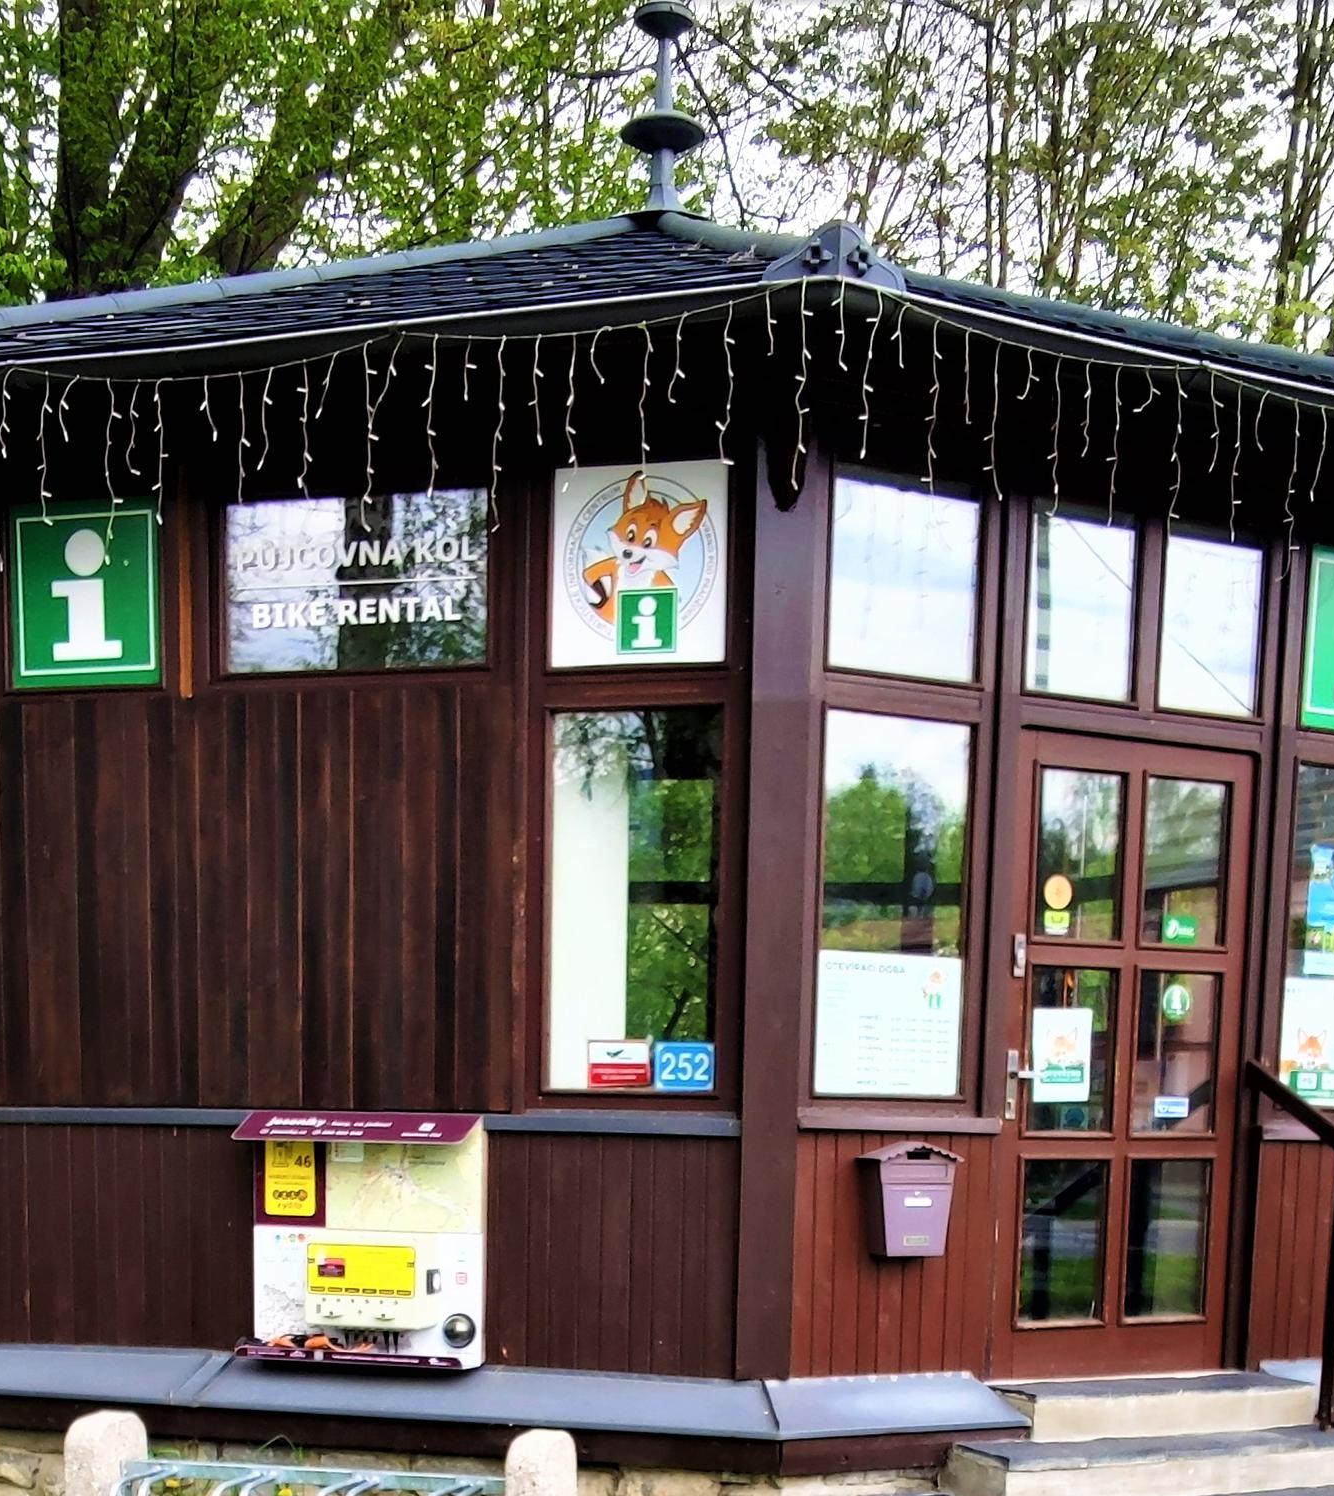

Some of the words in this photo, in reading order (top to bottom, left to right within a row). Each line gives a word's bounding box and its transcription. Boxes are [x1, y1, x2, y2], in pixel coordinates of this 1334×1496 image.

[236, 538, 403, 573] PŮJČOVNA
[414, 536, 479, 564] KOL
[252, 602, 327, 629] BIKE
[337, 596, 462, 626] RENTAL
[661, 1052, 710, 1082] 252
[294, 1155, 312, 1168] 46
